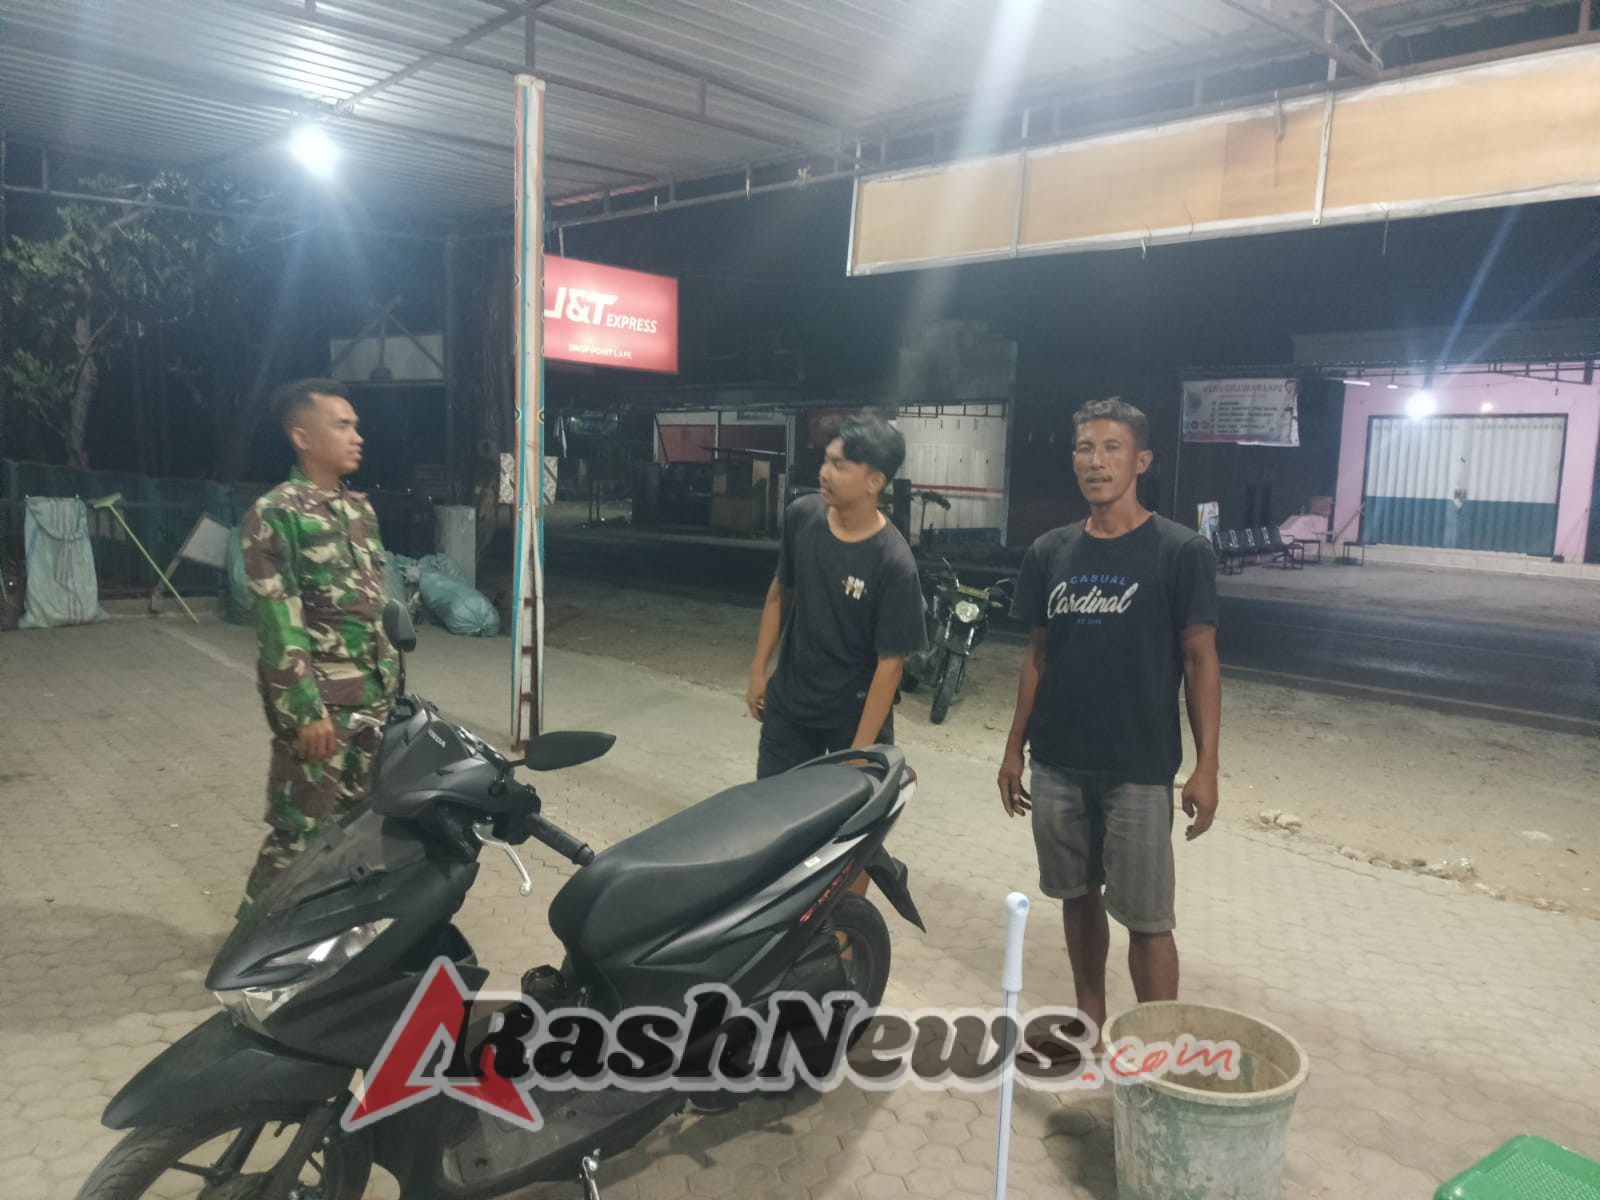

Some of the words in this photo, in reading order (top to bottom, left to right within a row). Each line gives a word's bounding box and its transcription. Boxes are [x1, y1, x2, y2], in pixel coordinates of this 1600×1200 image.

[544, 286, 619, 326] J&T
[605, 313, 657, 333] EXPRESS
[568, 343, 590, 353] DROP
[1070, 574, 1126, 586] CASUAL
[1047, 581, 1139, 619] Cardinal
